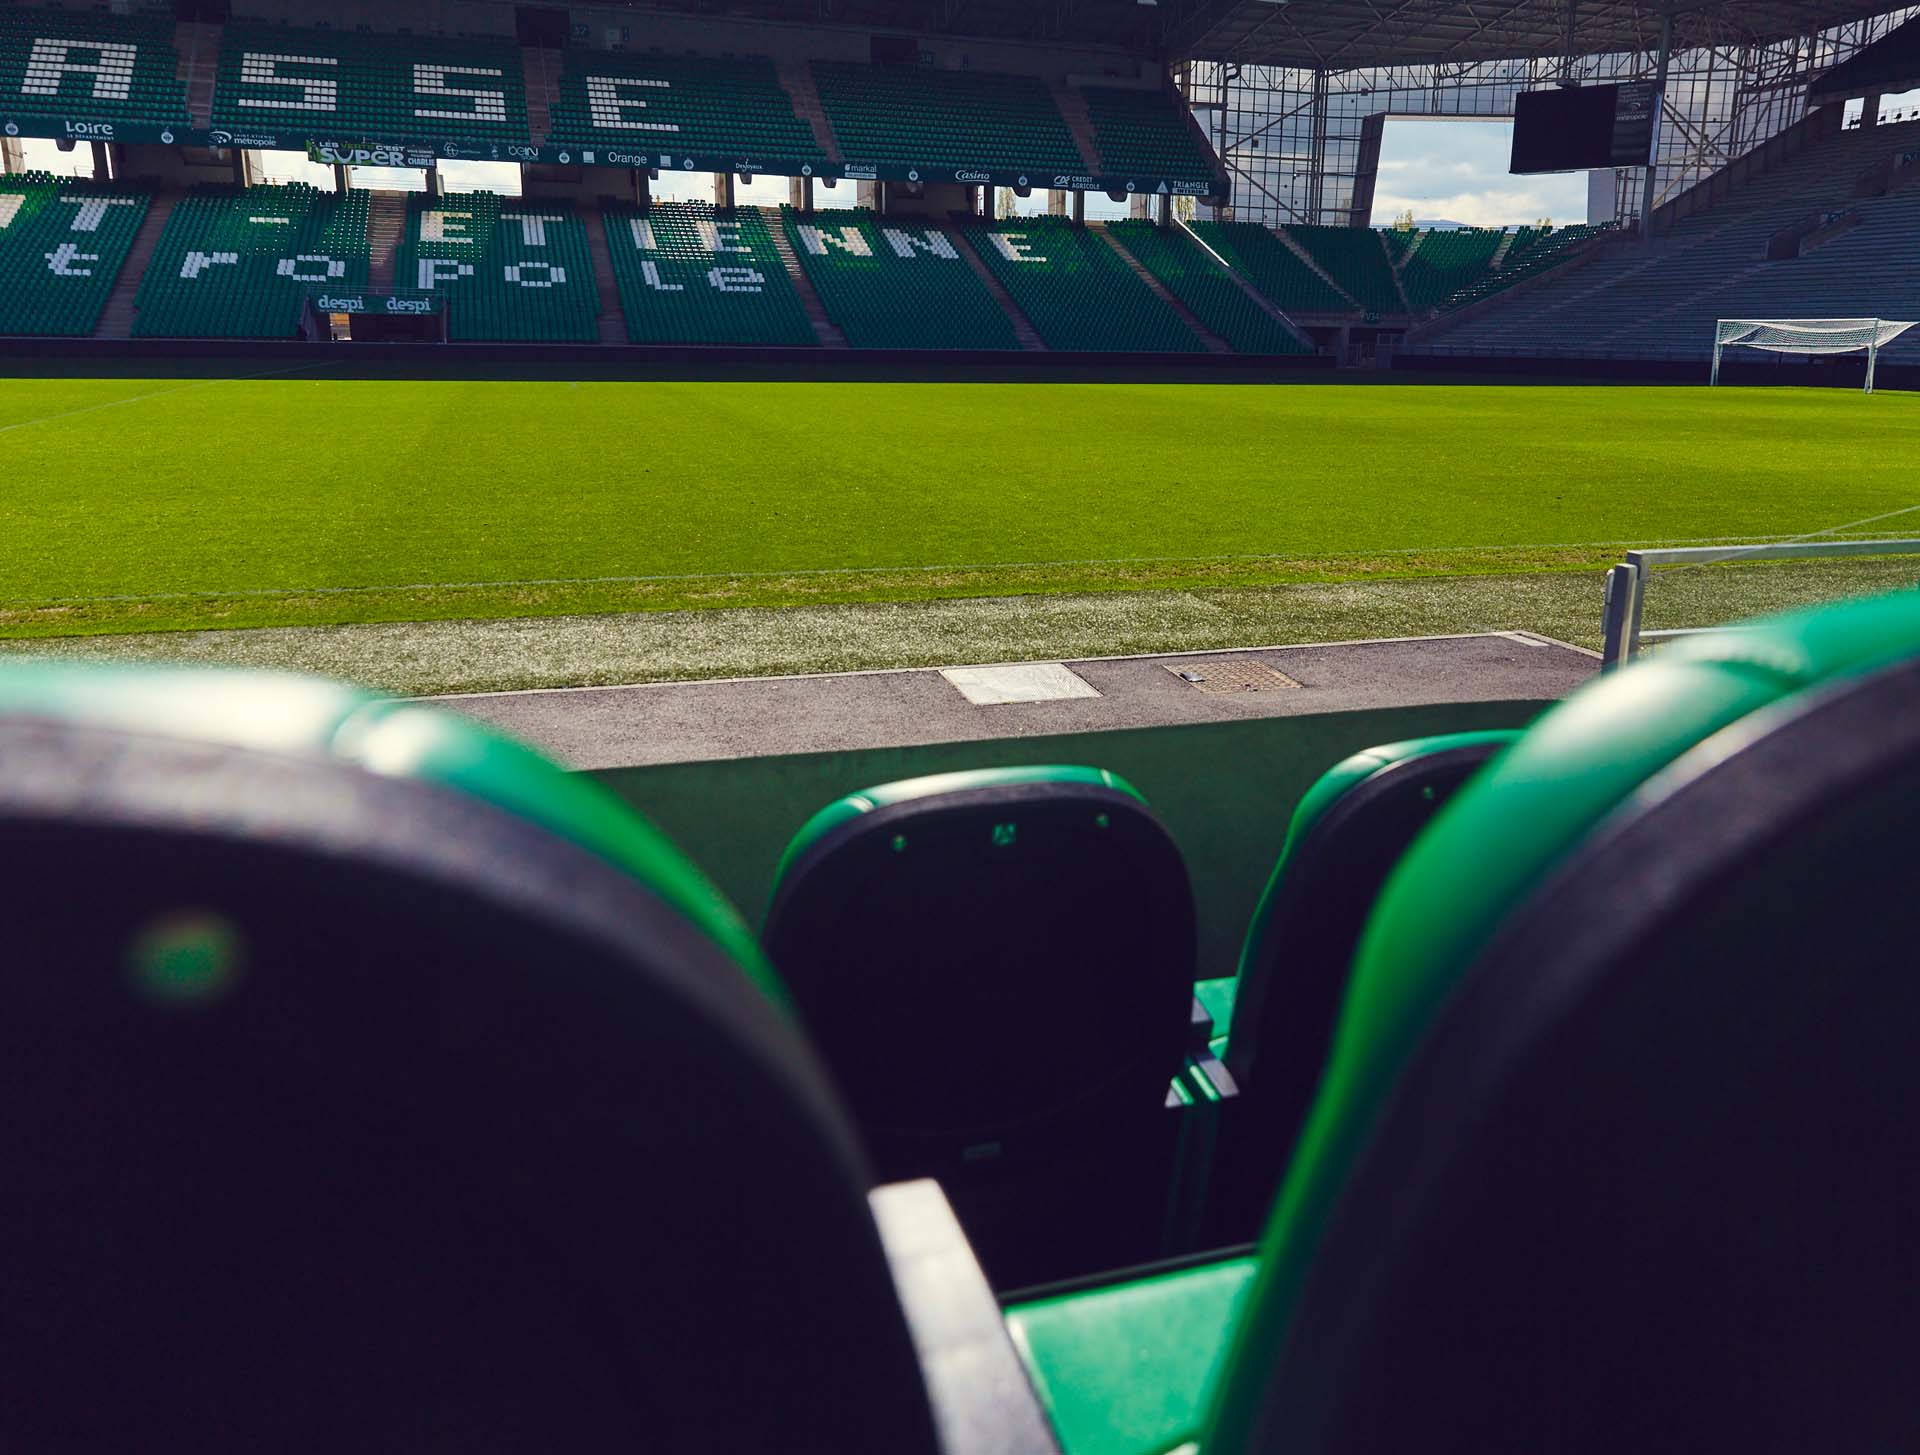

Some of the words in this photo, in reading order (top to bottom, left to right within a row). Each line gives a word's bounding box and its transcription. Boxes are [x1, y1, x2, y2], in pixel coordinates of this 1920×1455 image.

[65, 120, 113, 135] Loire
[608, 151, 647, 166] Orange
[851, 164, 876, 173] markal
[955, 169, 990, 180] Casino
[1072, 182, 1100, 190] AGRICOLE
[1173, 181, 1209, 189] TRIANGLE
[318, 295, 364, 312] despi
[386, 297, 431, 314] despi
